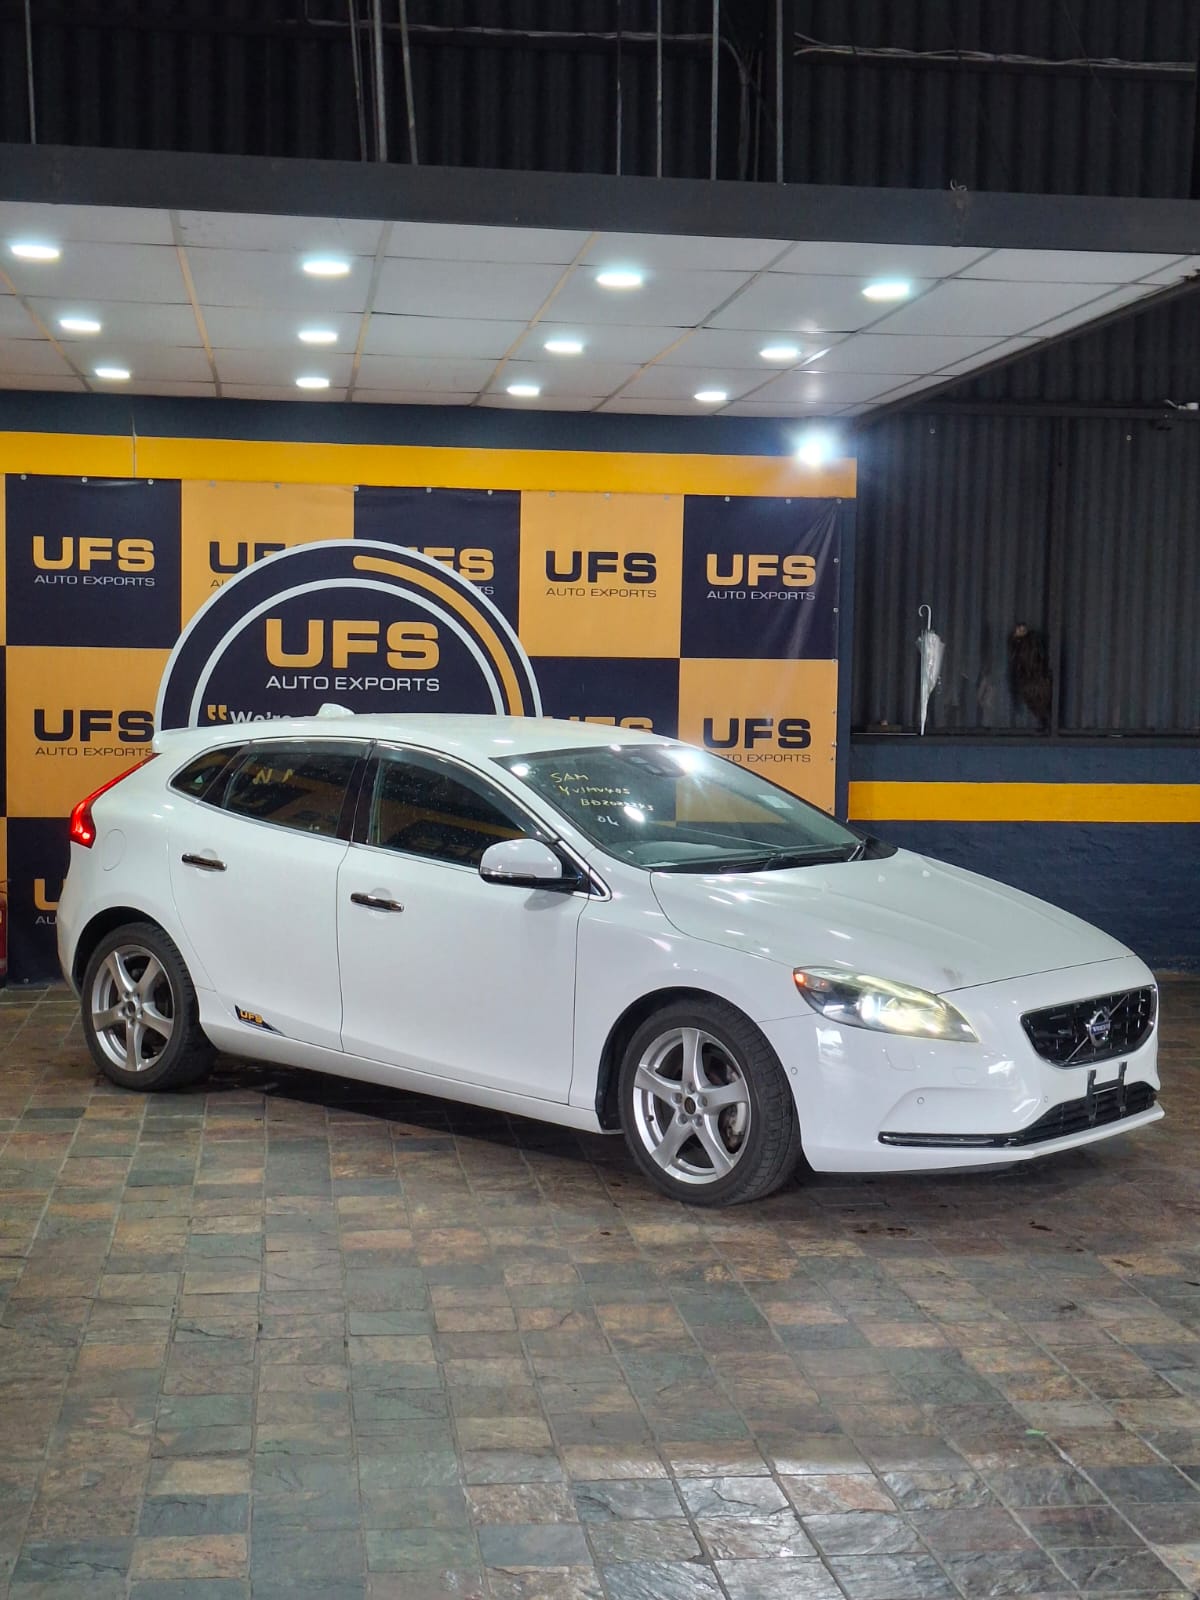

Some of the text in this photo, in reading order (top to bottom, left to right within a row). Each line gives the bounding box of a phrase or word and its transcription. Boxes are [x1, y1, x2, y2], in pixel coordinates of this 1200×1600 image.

[33, 535, 155, 572] UFS
[209, 541, 303, 574] UF
[546, 550, 657, 584] UFS
[706, 553, 816, 587] UFS
[34, 574, 155, 587] AUTO EXPORTS
[546, 587, 657, 598] AUTO EXPORTS
[706, 590, 816, 601] AUTO EXPORTS
[265, 618, 440, 670] UFS
[265, 675, 440, 692] AUTO EXPORTS
[34, 709, 154, 742] UFS
[703, 717, 811, 749] UFS
[35, 747, 153, 757] AUTO EXPORTS
[747, 754, 811, 763] EXPORTS
[240, 1010, 264, 1025] UFS
